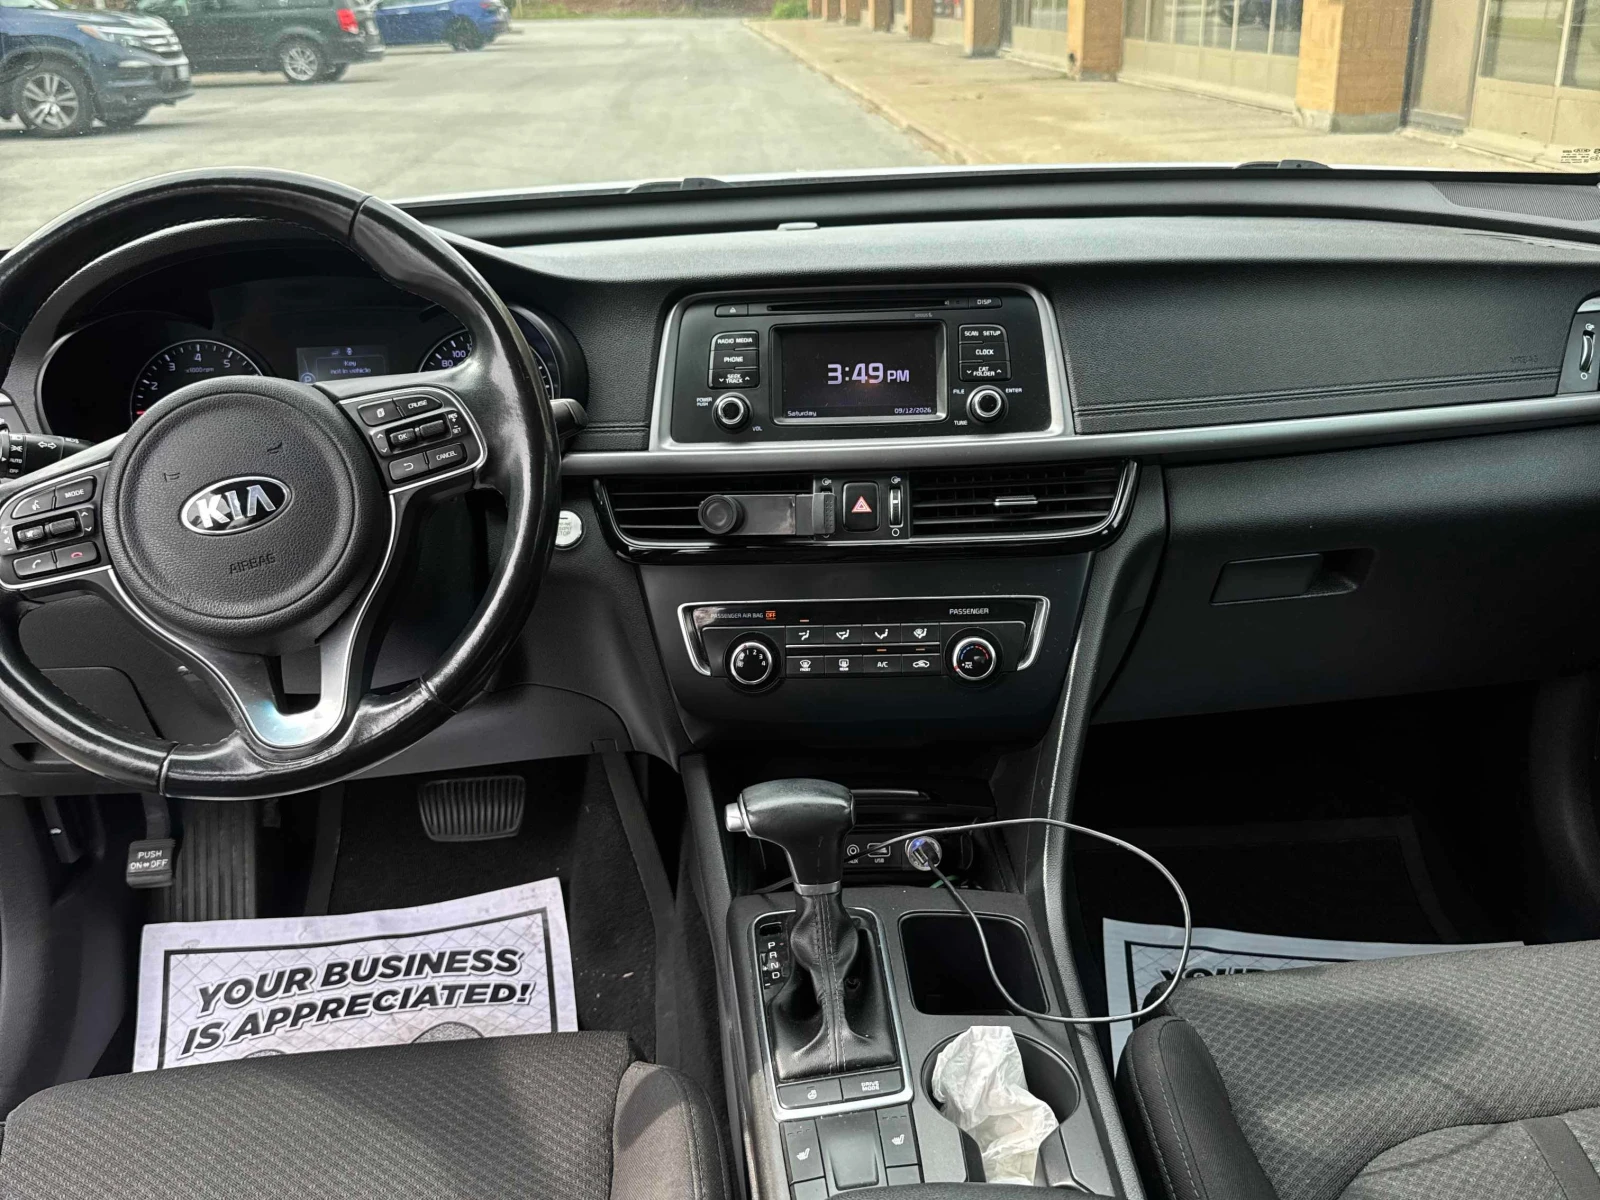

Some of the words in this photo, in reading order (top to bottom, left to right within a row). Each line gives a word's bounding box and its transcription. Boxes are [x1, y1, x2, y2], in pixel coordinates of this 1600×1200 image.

[194, 353, 202, 362] 4
[452, 350, 466, 358] 100
[168, 362, 176, 371] 3
[223, 360, 231, 368] 5
[441, 360, 454, 368] 80
[827, 363, 884, 385] 3:49
[887, 369, 910, 383] PM
[151, 382, 158, 390] 2
[407, 399, 428, 409] CRUISE
[398, 432, 407, 440] OK
[436, 450, 457, 461] CANCEL
[64, 488, 85, 499] MODE
[196, 485, 277, 528] KIA
[229, 553, 276, 574] AIRBAG
[137, 850, 163, 859] PUSH
[130, 861, 142, 870] ON
[151, 858, 169, 868] OFF
[767, 941, 776, 949] P
[769, 951, 777, 959] R
[770, 961, 779, 969] N
[771, 971, 781, 979] D
[199, 966, 312, 1013] YOUR
[320, 949, 524, 988] BUSINESS
[180, 1021, 225, 1056] IS
[228, 982, 531, 1042] APPRECIATED!
